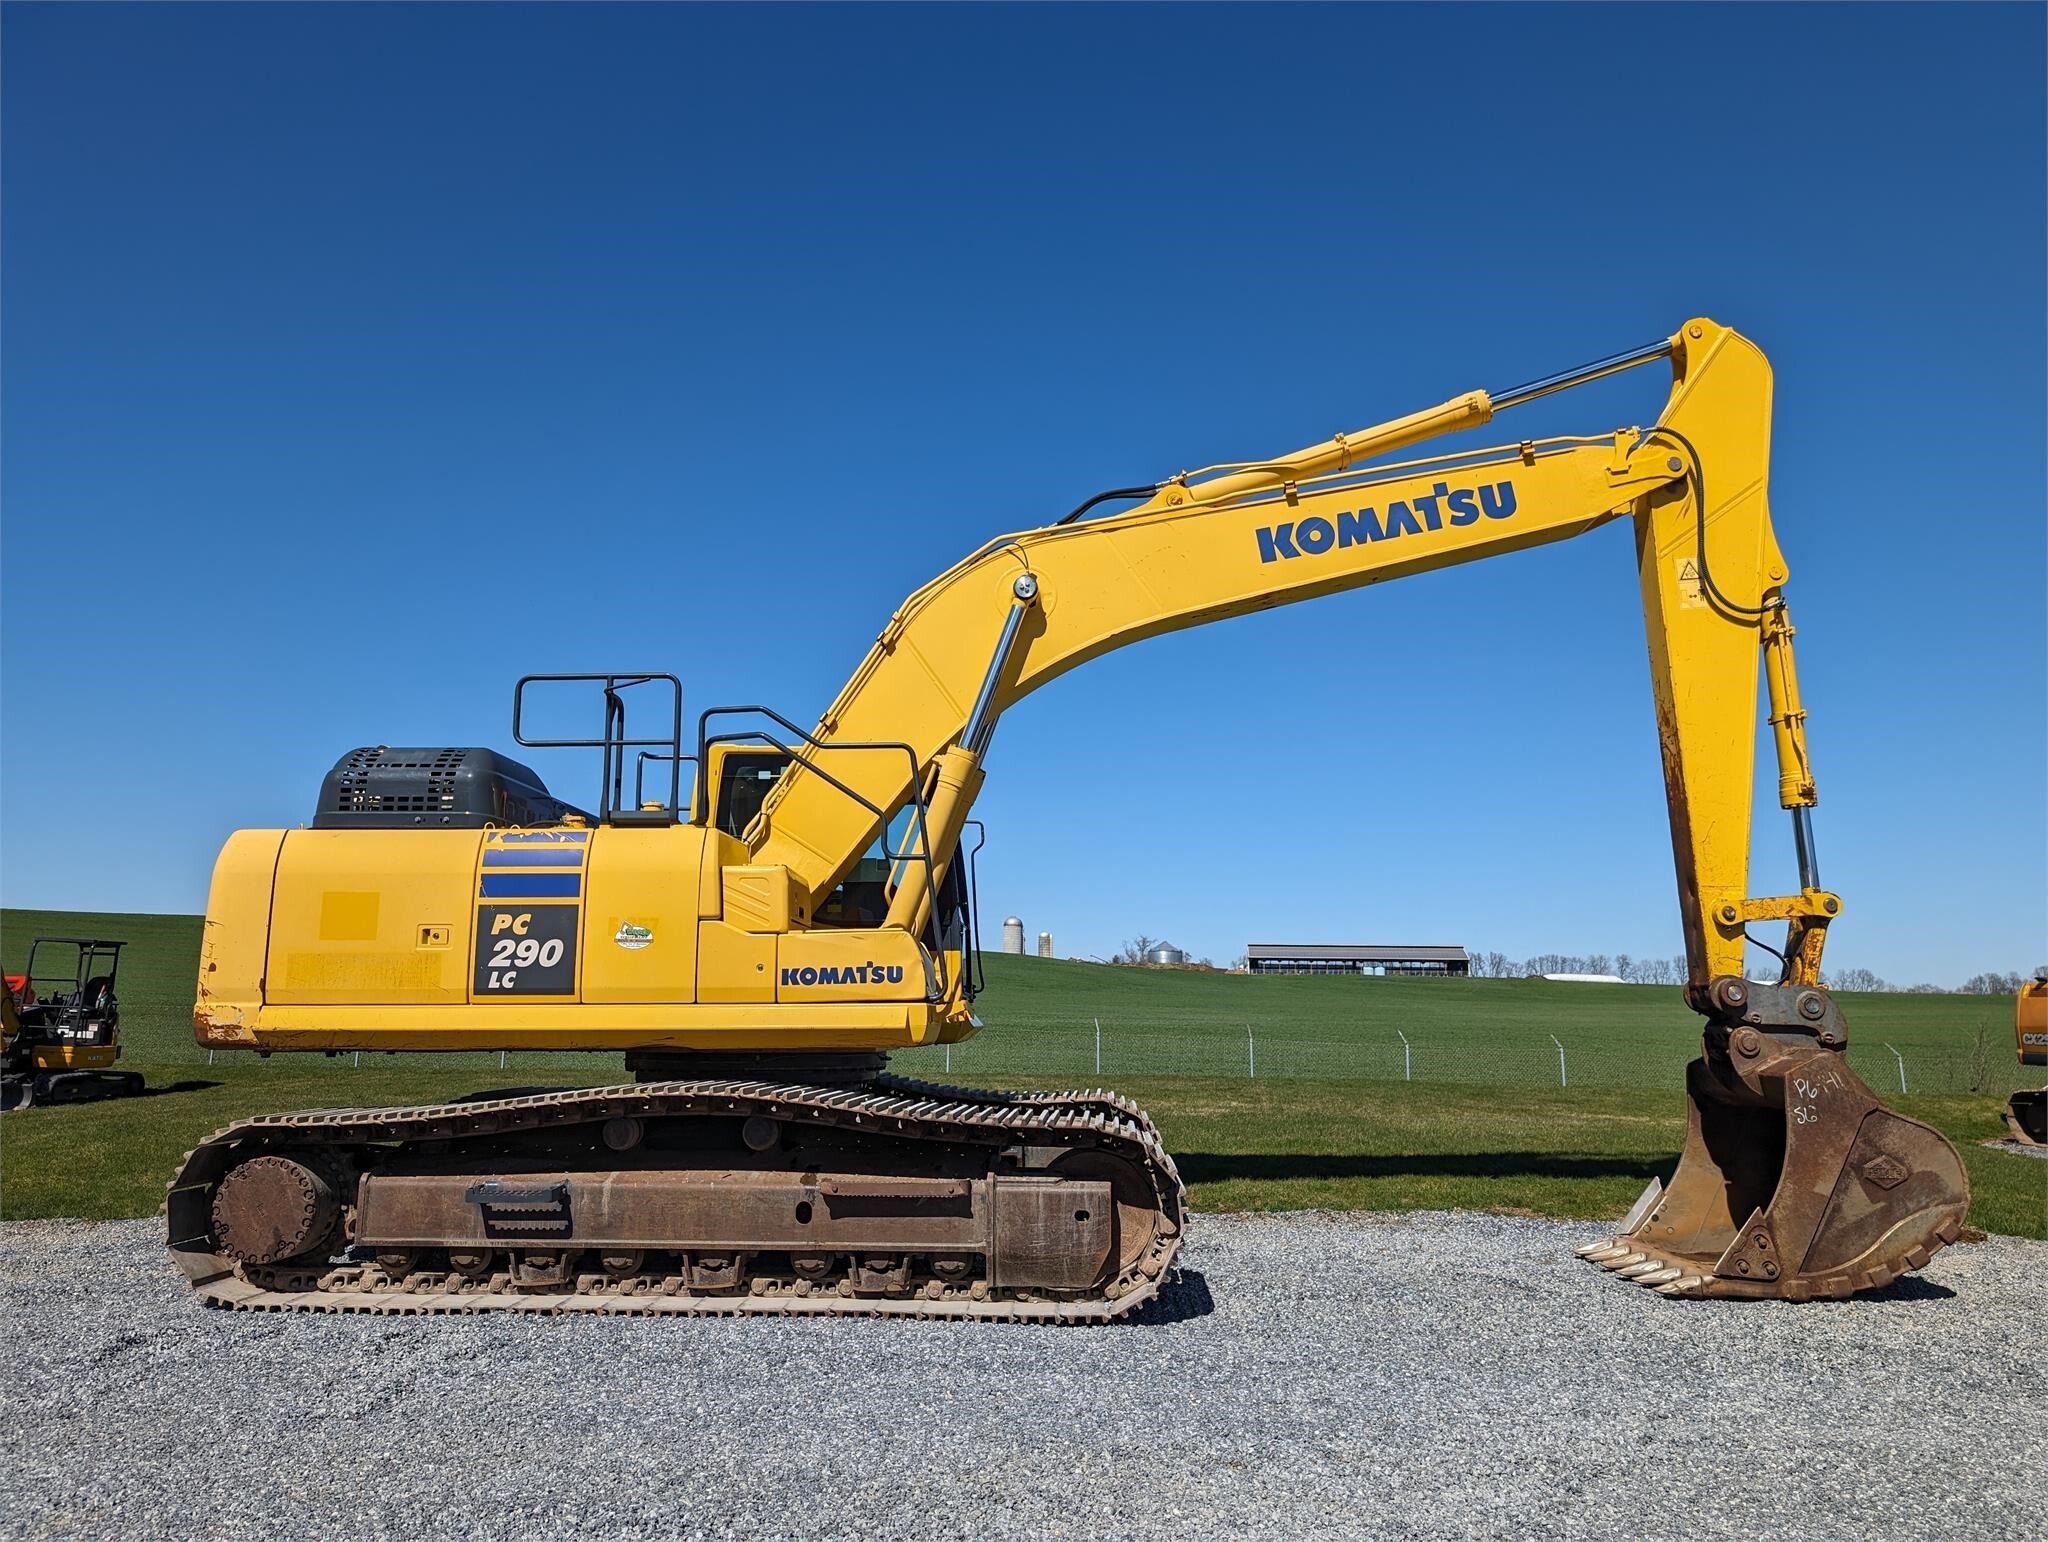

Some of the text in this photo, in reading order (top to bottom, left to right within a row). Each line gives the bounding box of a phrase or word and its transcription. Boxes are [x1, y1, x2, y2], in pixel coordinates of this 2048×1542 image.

[1255, 481, 1518, 564] KOMATSU
[490, 913, 532, 935] PC
[487, 938, 564, 968] 290
[487, 971, 517, 989] LC
[781, 961, 904, 986] KOMATSU
